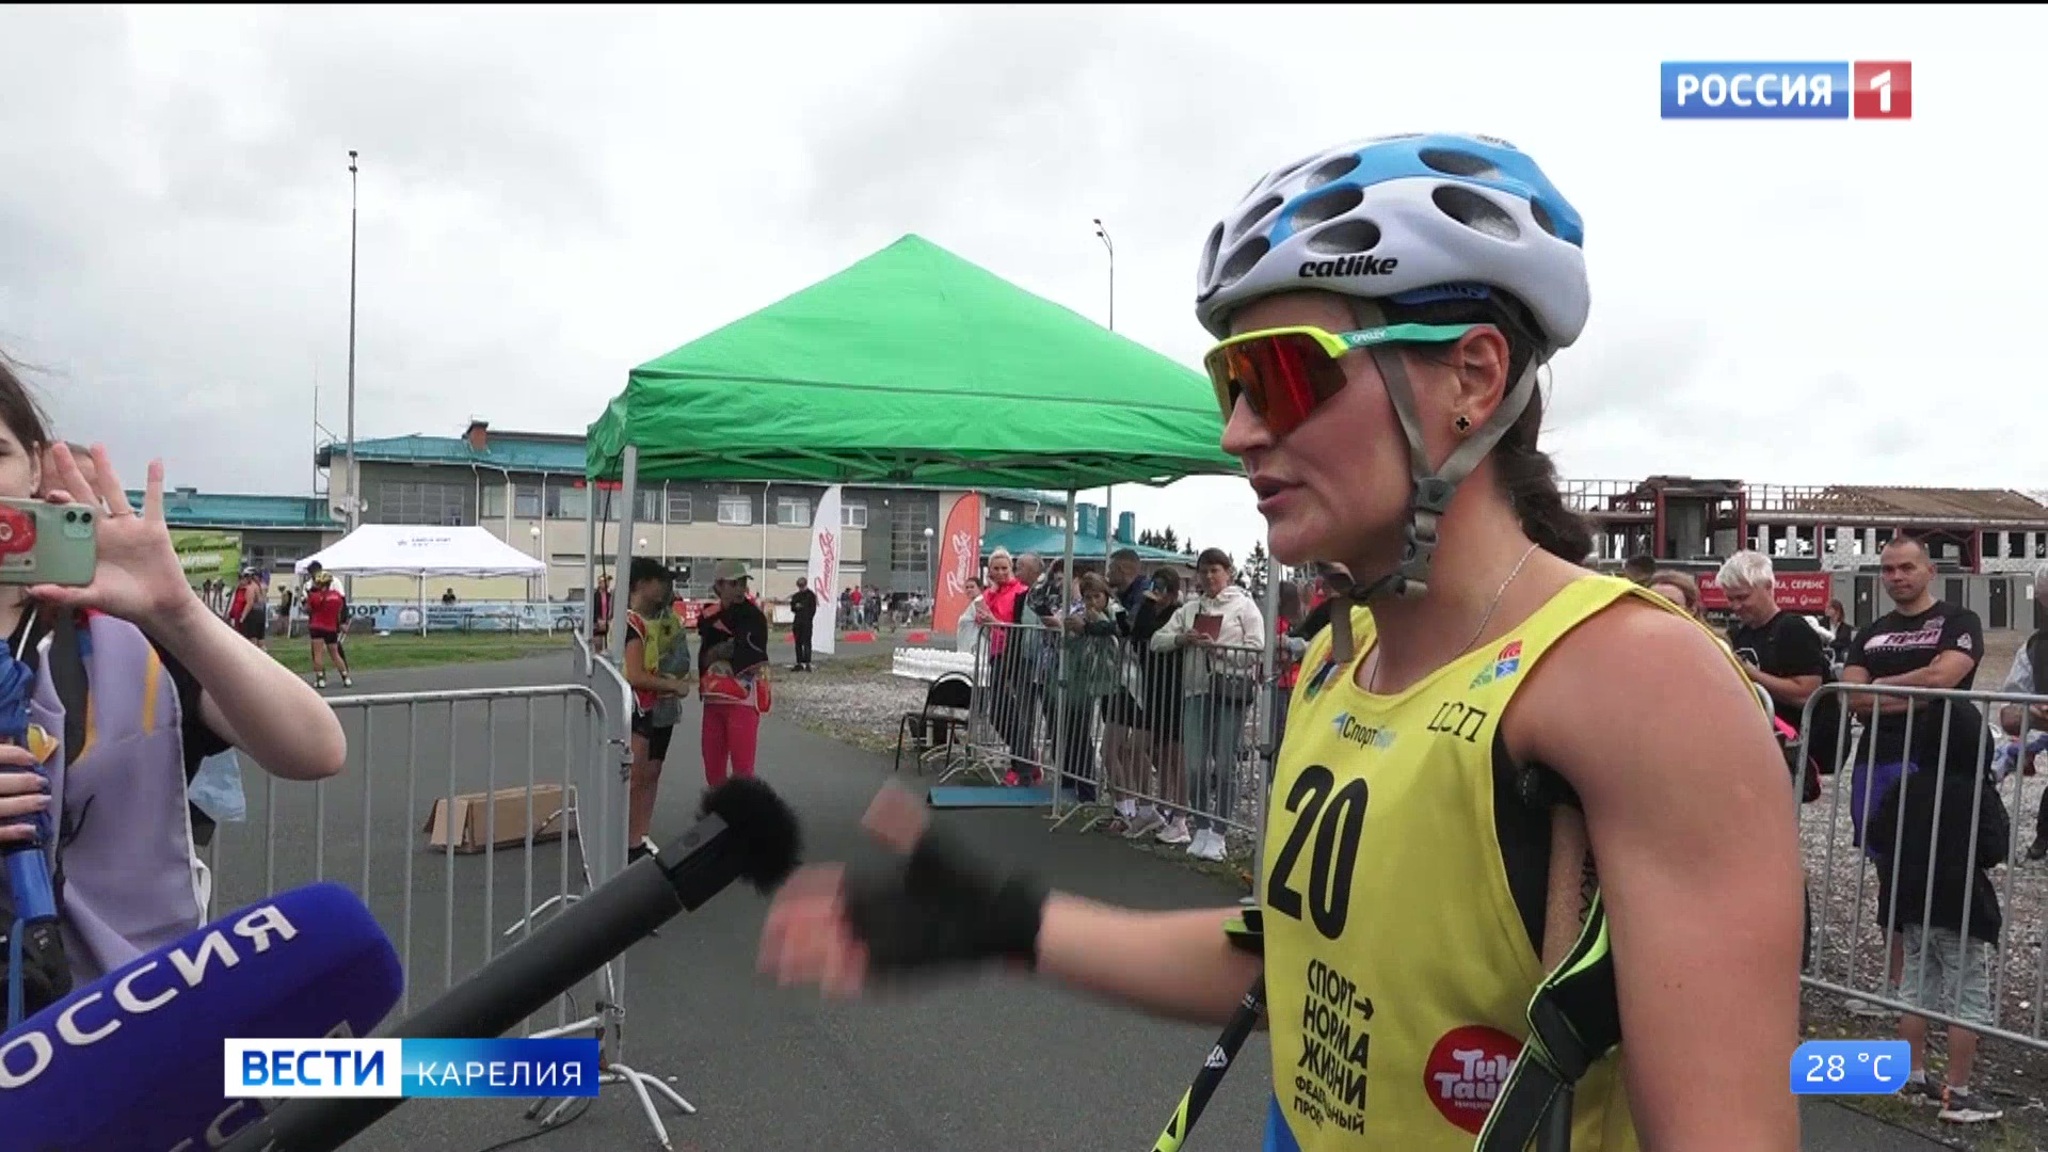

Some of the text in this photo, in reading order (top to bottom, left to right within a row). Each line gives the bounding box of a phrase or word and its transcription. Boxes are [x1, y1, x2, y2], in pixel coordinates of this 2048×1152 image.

[1299, 255, 1398, 278] catlike
[346, 604, 387, 618] ПОРТ
[1790, 579, 1825, 590] СЕРВИС
[1267, 764, 1369, 940] 20
[0, 904, 298, 1089] ОССИЯ
[1307, 958, 1357, 1018] СПОРТ
[1303, 994, 1370, 1070] НОРМА
[1297, 1033, 1367, 1111] ЖИЗНИ
[1294, 1075, 1365, 1136] ФЕДНЫЙ
